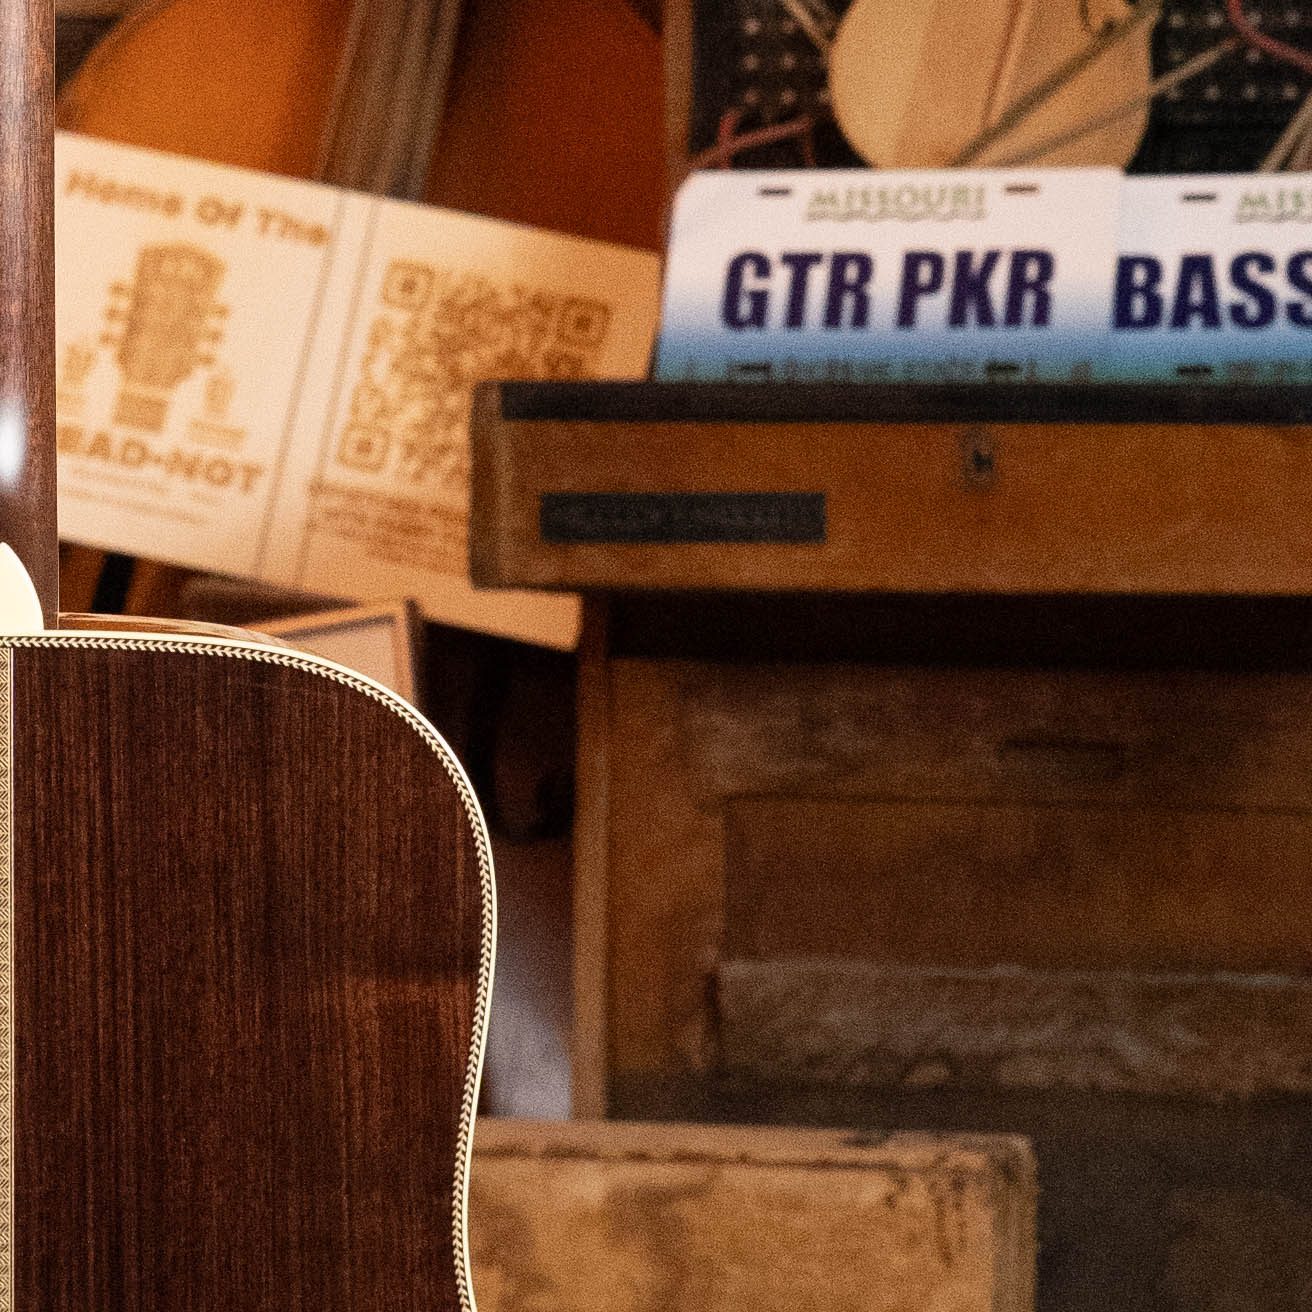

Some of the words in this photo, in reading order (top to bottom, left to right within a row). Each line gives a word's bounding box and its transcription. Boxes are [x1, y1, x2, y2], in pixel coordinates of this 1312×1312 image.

[65, 170, 182, 216] Home
[193, 194, 249, 231] Of
[254, 206, 331, 246] The
[805, 185, 987, 214] MISSOURI
[721, 250, 875, 331] GTR
[896, 248, 1056, 330] PKR
[1113, 251, 1312, 331] BASS
[57, 426, 263, 494] EAD-NOT
